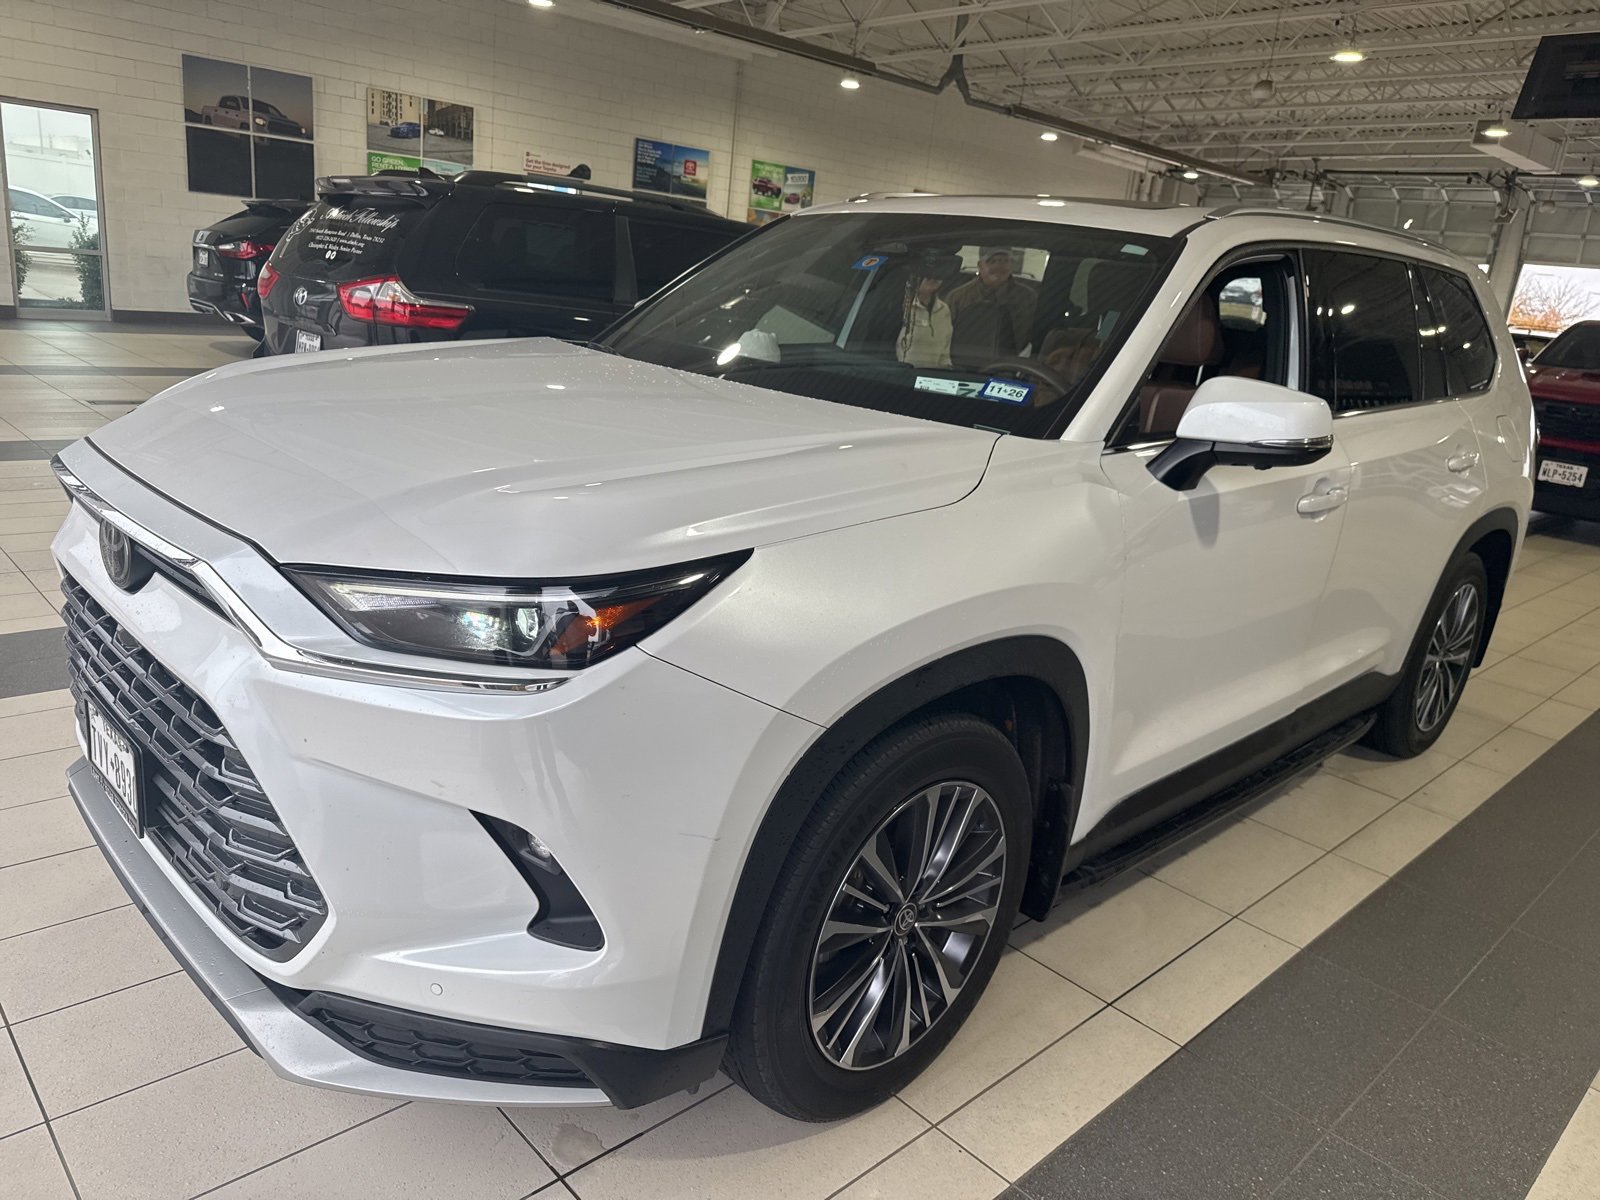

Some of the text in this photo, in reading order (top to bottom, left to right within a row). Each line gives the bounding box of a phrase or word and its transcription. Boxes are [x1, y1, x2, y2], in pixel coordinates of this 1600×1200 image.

[371, 155, 382, 163] GO
[320, 205, 359, 221] Atioch
[1556, 463, 1574, 471] TEXAS
